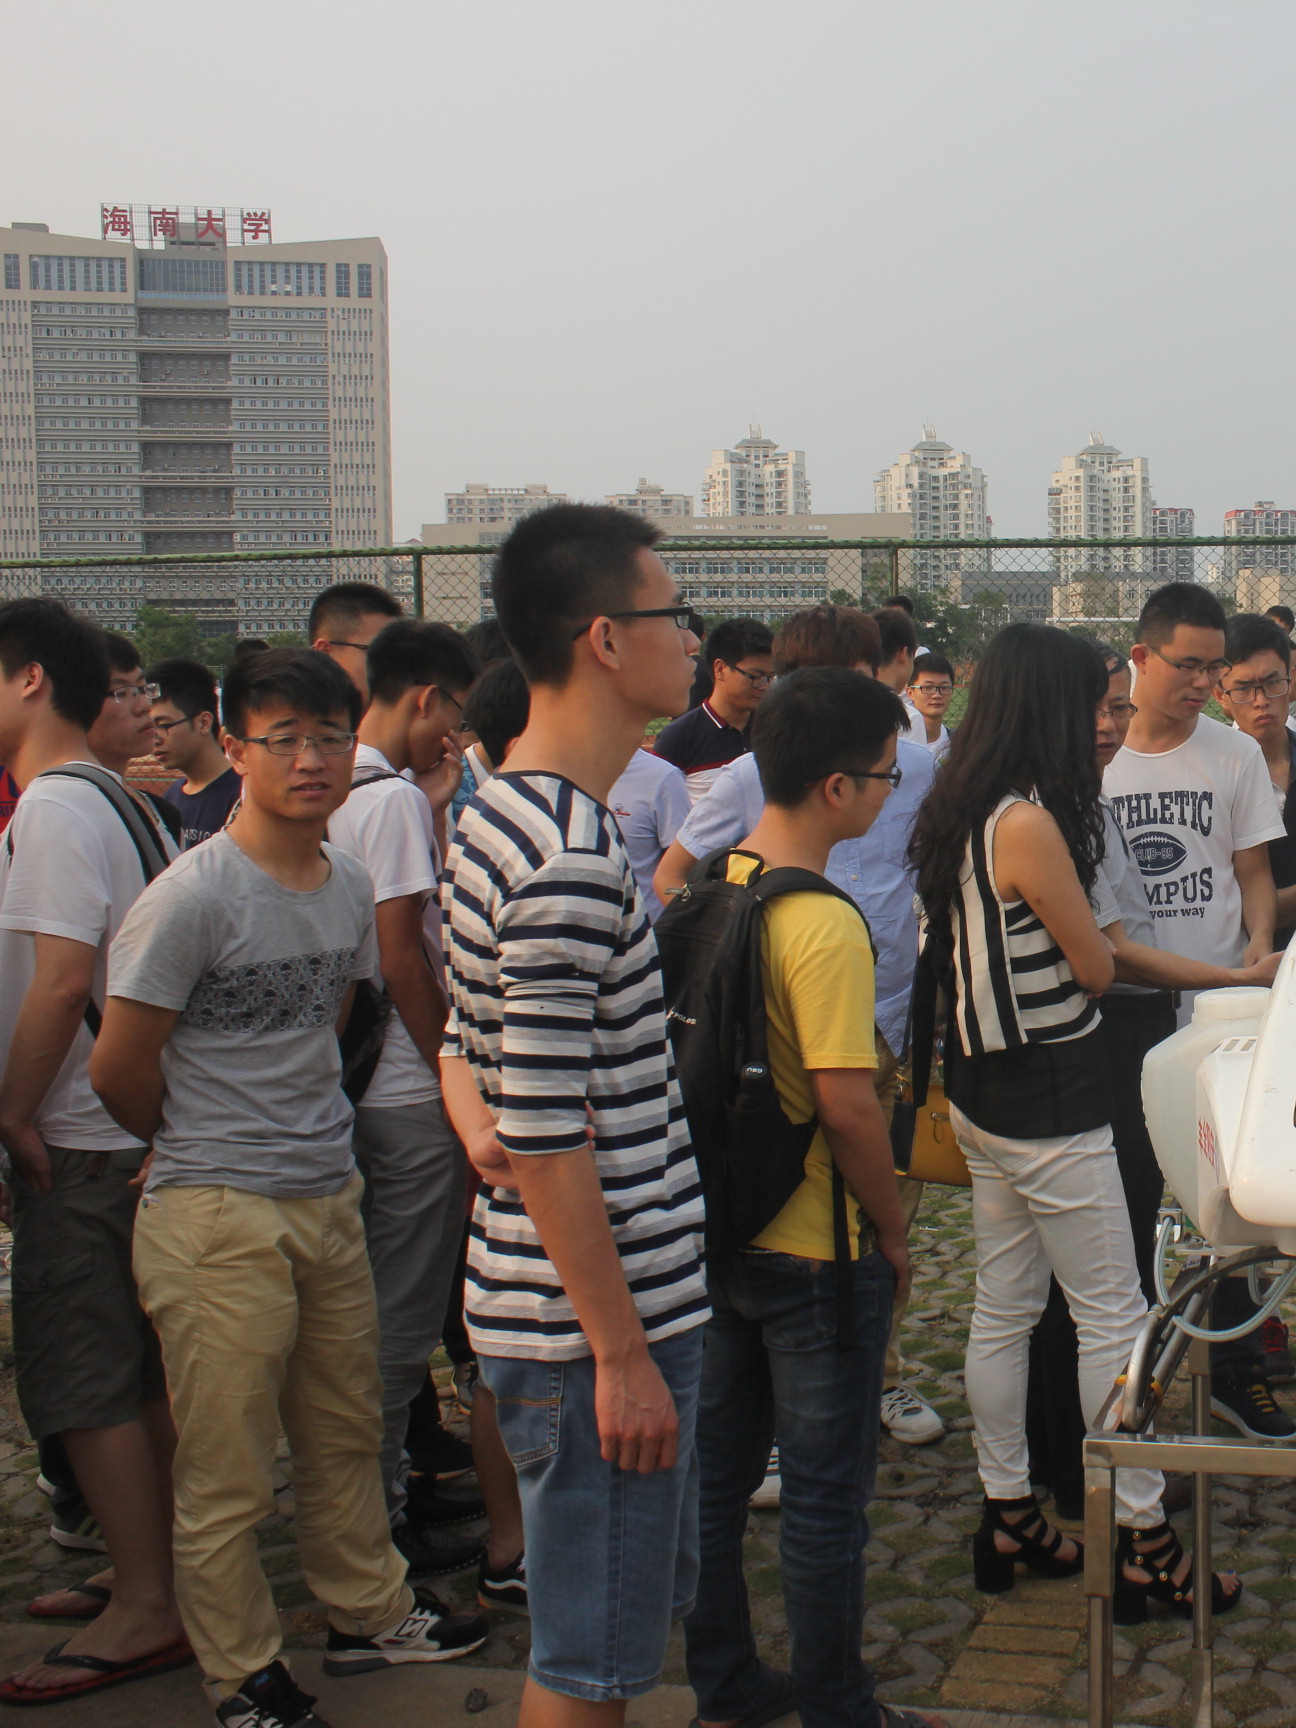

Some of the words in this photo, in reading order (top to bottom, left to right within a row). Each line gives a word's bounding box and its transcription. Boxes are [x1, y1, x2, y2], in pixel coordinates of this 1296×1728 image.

[103, 206, 269, 240] 海南大学
[1110, 790, 1213, 837] THLETIC
[1143, 866, 1214, 906] MPUS
[1180, 907, 1205, 919] way
